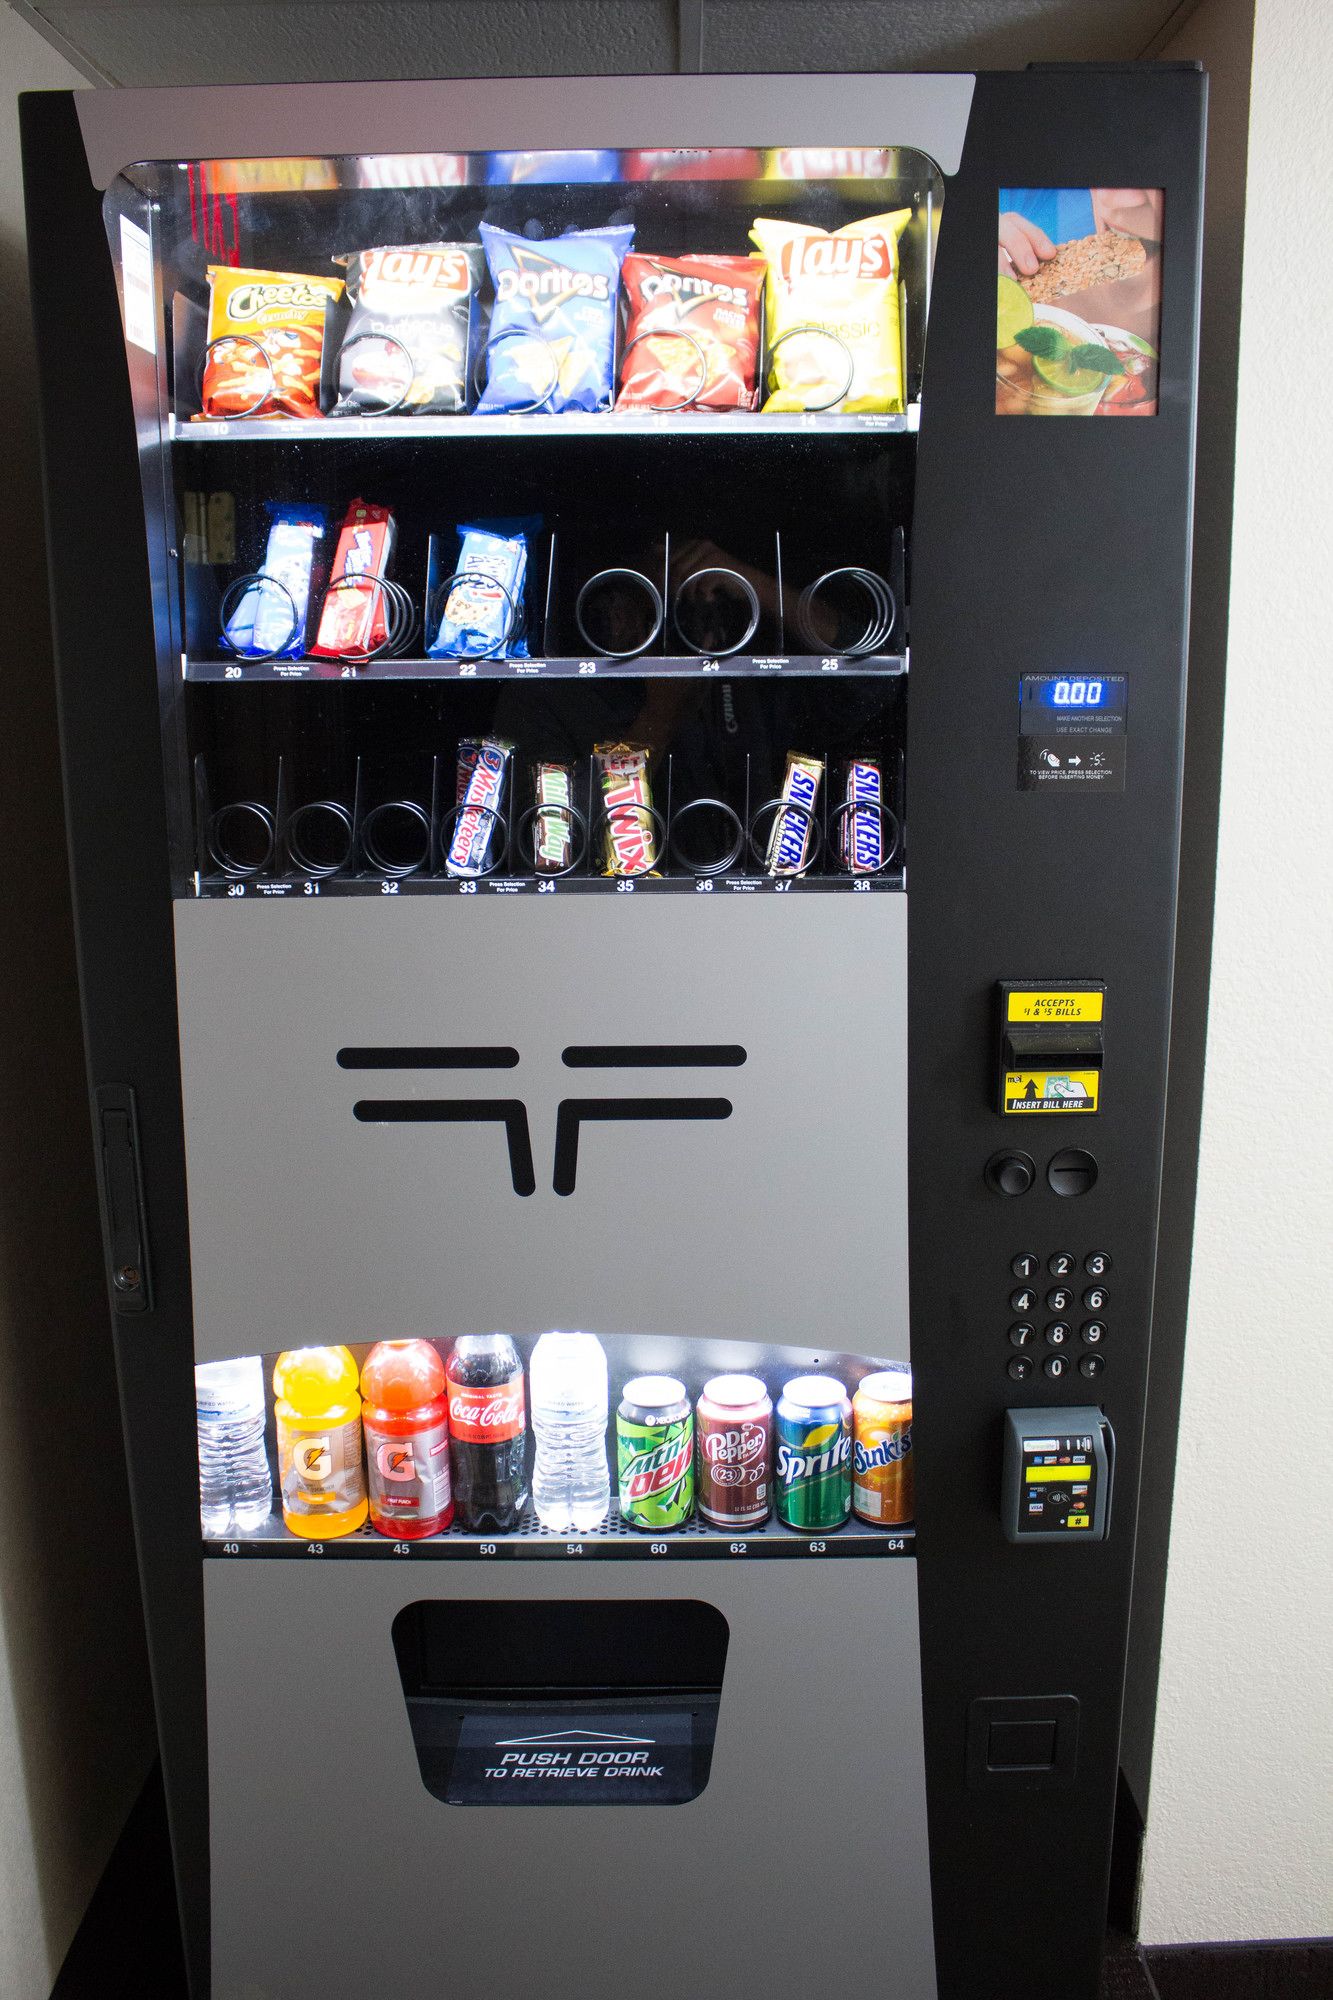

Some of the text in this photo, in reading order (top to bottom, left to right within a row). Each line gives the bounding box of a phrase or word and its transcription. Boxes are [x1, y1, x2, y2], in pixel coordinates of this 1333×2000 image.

[498, 269, 608, 302] Doritos
[641, 273, 747, 306] Doritos
[229, 283, 327, 320] Cheetos
[798, 414, 815, 427] 14
[212, 423, 228, 436] 10
[459, 664, 477, 676] 22
[579, 662, 596, 674] 23
[702, 660, 720, 671] 24
[821, 659, 839, 671] 25
[225, 667, 242, 678] 20
[341, 666, 357, 678] 21
[483, 750, 499, 770] 3
[601, 756, 641, 771] LEFT
[539, 818, 571, 863] Way
[227, 884, 245, 896] 30
[303, 882, 320, 895] 31
[381, 881, 399, 894] 32
[459, 880, 477, 893] 33
[537, 880, 555, 893] 34
[616, 880, 634, 892] 35
[696, 879, 713, 892] 36
[775, 879, 792, 892] 37
[853, 879, 871, 891] 38
[1034, 999, 1075, 1007] ACCEPTS
[1033, 1008, 1040, 1016] &
[1044, 1008, 1052, 1016] $5
[1055, 1008, 1081, 1016] BILLS
[1012, 1099, 1083, 1109] INSERT BILL HERE
[1021, 1257, 1104, 1276] 1 2 3
[1017, 1291, 1102, 1310] 4 5 6
[1018, 1325, 1101, 1344] 7 8 9
[1051, 1359, 1062, 1376] 0
[450, 1394, 519, 1427] Coca-Cola
[726, 1430, 750, 1448] Dr
[706, 1433, 762, 1463] Pepper
[854, 1424, 912, 1475] Sunkis
[292, 1436, 332, 1481] G
[376, 1442, 416, 1482] G
[628, 1440, 681, 1476] Mtn
[776, 1433, 851, 1485] Sprite
[719, 1469, 733, 1481] 23
[223, 1543, 239, 1554] 40
[307, 1543, 324, 1554] 43
[393, 1543, 410, 1554] 45
[479, 1544, 496, 1554] 50
[566, 1543, 583, 1554] 54
[650, 1543, 667, 1554] 60
[730, 1542, 747, 1554] 62
[809, 1541, 826, 1552] 63
[888, 1539, 905, 1551] 64
[501, 1752, 649, 1765] PUSH DOOR
[484, 1766, 664, 1778] TO RETRIEVE DRINK
